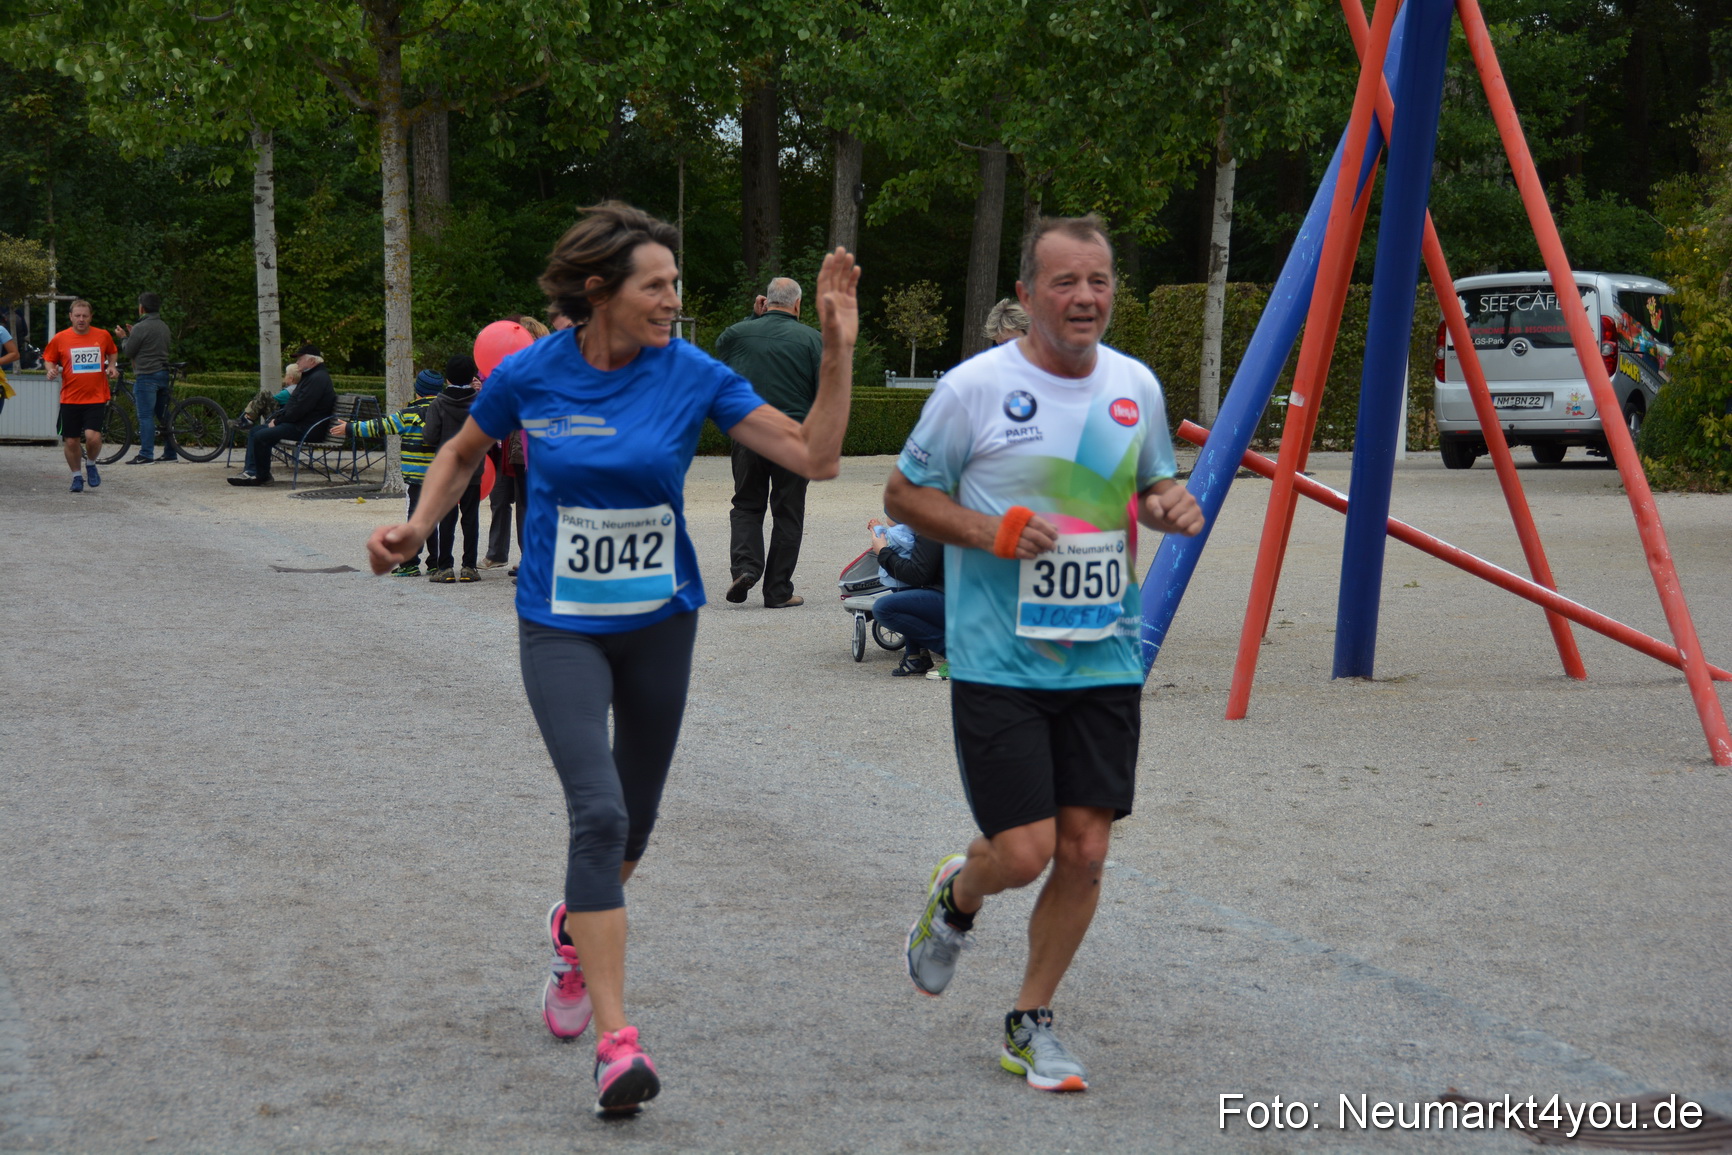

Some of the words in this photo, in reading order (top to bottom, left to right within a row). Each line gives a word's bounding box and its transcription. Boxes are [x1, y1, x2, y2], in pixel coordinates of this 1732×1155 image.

[1508, 326, 1522, 334] DER
[74, 353, 99, 363] 2827
[1496, 396, 1510, 405] NM
[1514, 396, 1528, 405] BN
[1528, 396, 1541, 405] 22
[1006, 426, 1043, 439] PARTL
[561, 514, 599, 531] PARTL
[602, 517, 657, 531] Neumarkt
[568, 532, 664, 574] 3042
[1067, 544, 1114, 555] Neumarkt
[1033, 559, 1120, 599] 3050
